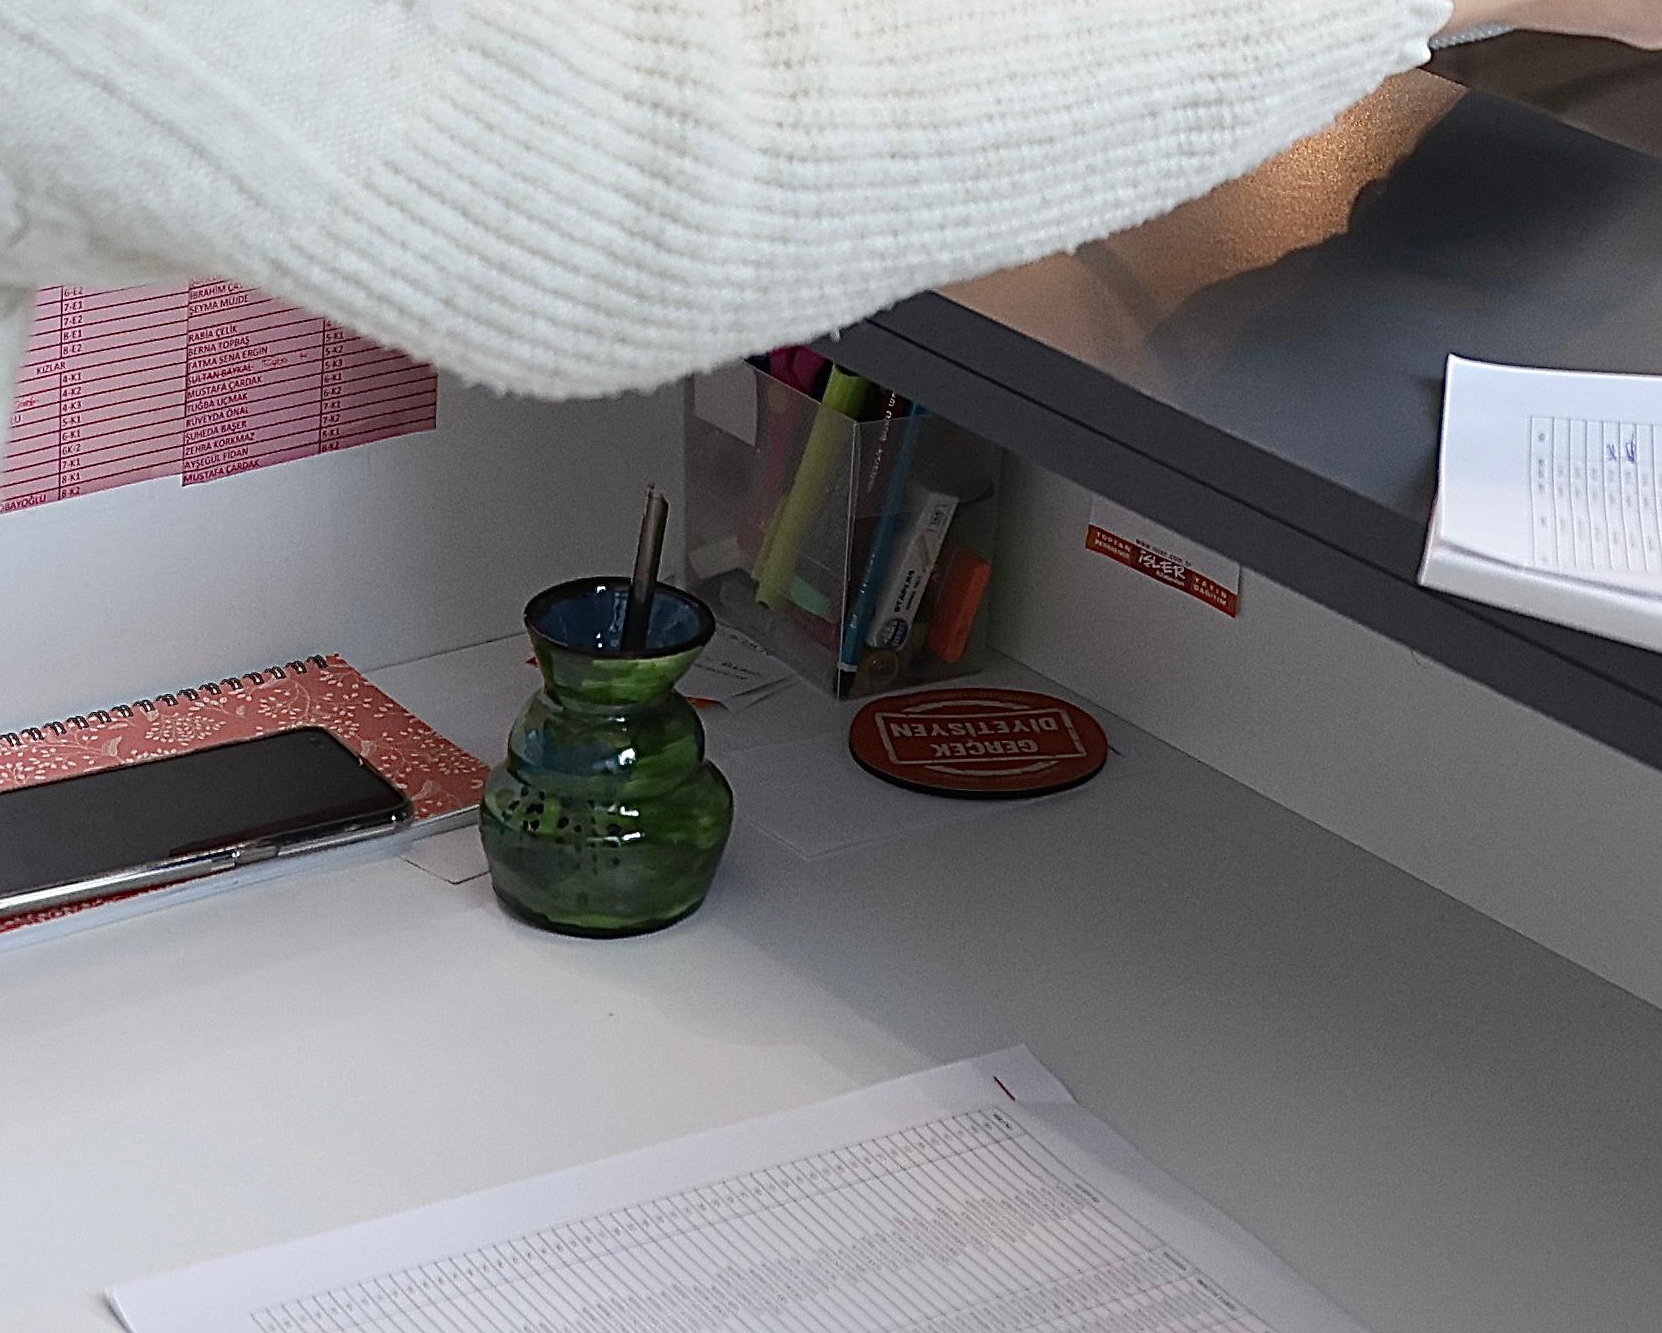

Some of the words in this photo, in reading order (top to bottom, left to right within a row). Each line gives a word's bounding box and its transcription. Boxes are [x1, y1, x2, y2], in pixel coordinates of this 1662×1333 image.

[188, 344, 216, 356] BERNA
[218, 336, 250, 350] TOPBAŞ
[36, 361, 66, 375] KIZLAR
[188, 357, 217, 370] FATMA
[219, 352, 241, 364] SENA
[188, 383, 226, 398] MUSTAFA
[228, 376, 263, 392] ÇARDAK
[188, 400, 214, 413] TUĞBA
[216, 393, 248, 406] UÇMAK
[221, 420, 247, 434] BAŞER
[185, 442, 212, 456] ZEHRA
[214, 432, 255, 449] KORKMAZ
[223, 447, 249, 460] FİDAN
[183, 466, 224, 483] MUSTAFA
[226, 459, 260, 475] ÇARDAK
[891, 712, 1062, 738] DİYETİSYEN
[933, 738, 1040, 758] GERÇEK
